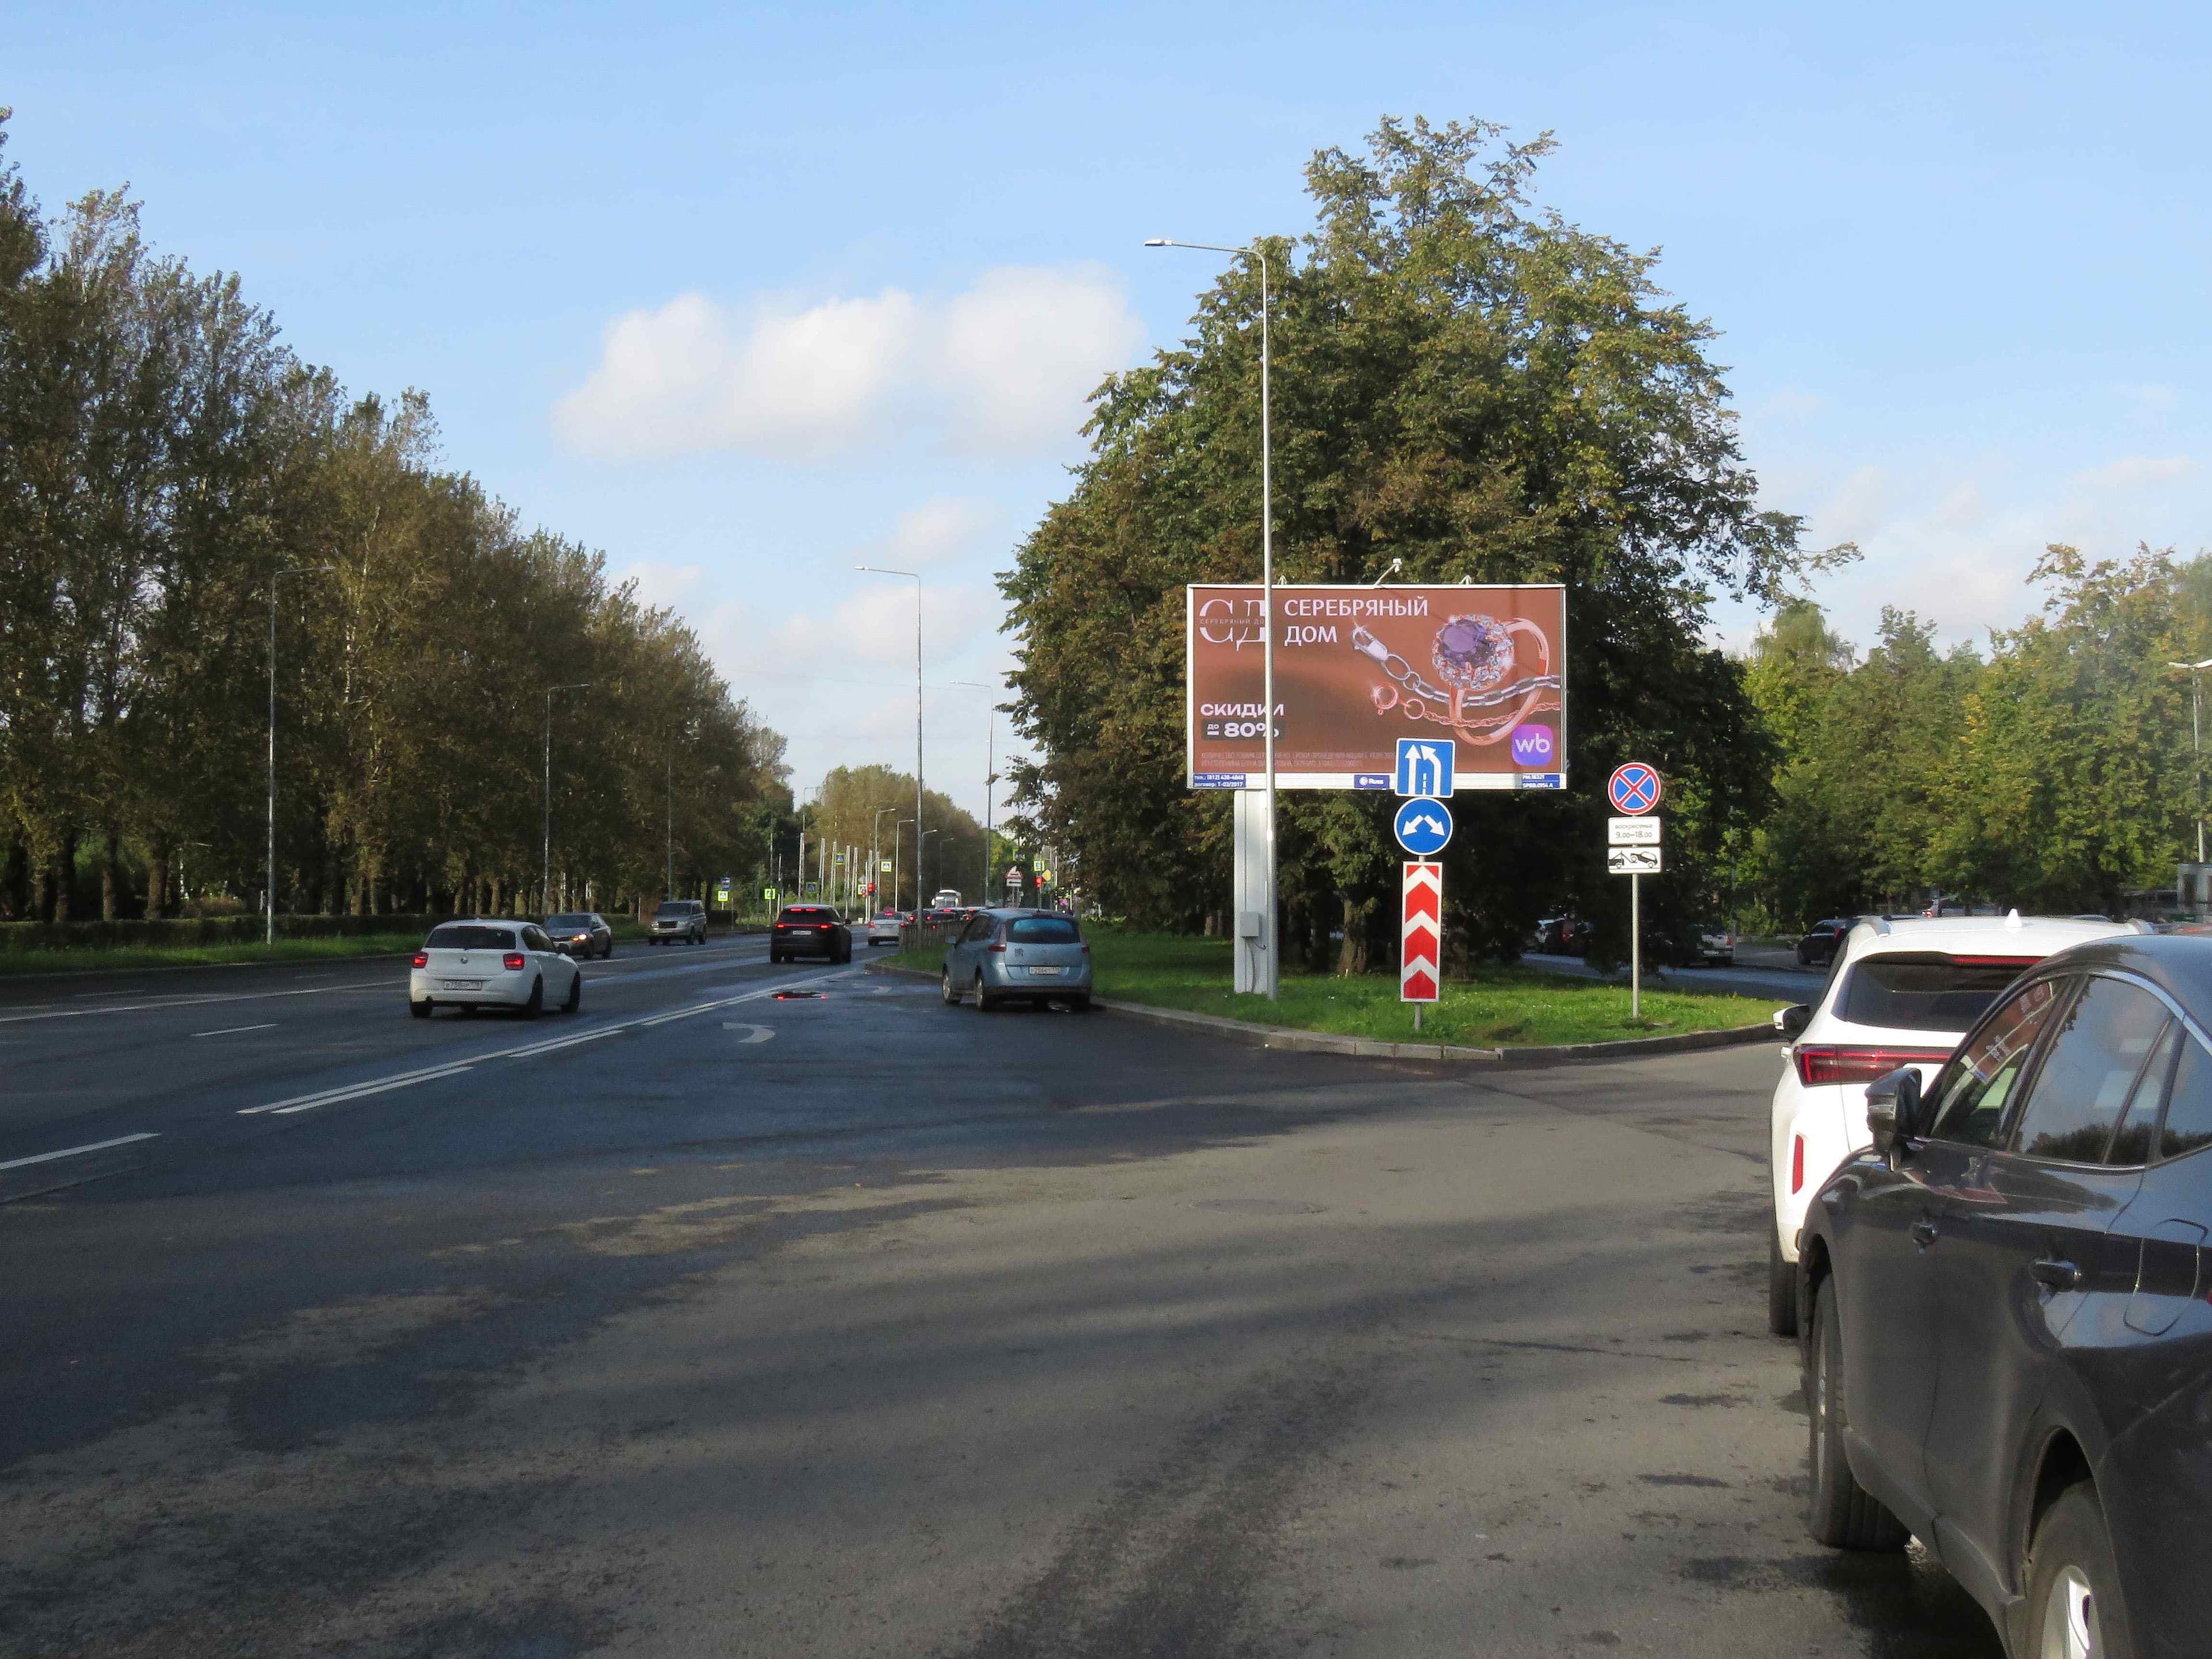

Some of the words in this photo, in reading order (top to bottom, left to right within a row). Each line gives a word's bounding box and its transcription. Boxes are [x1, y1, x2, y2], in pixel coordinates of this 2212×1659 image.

[1284, 596, 1429, 616] СЕРЕБРЯНЫЙ
[1284, 626, 1338, 646] ДОМ
[1514, 733, 1550, 753] wb
